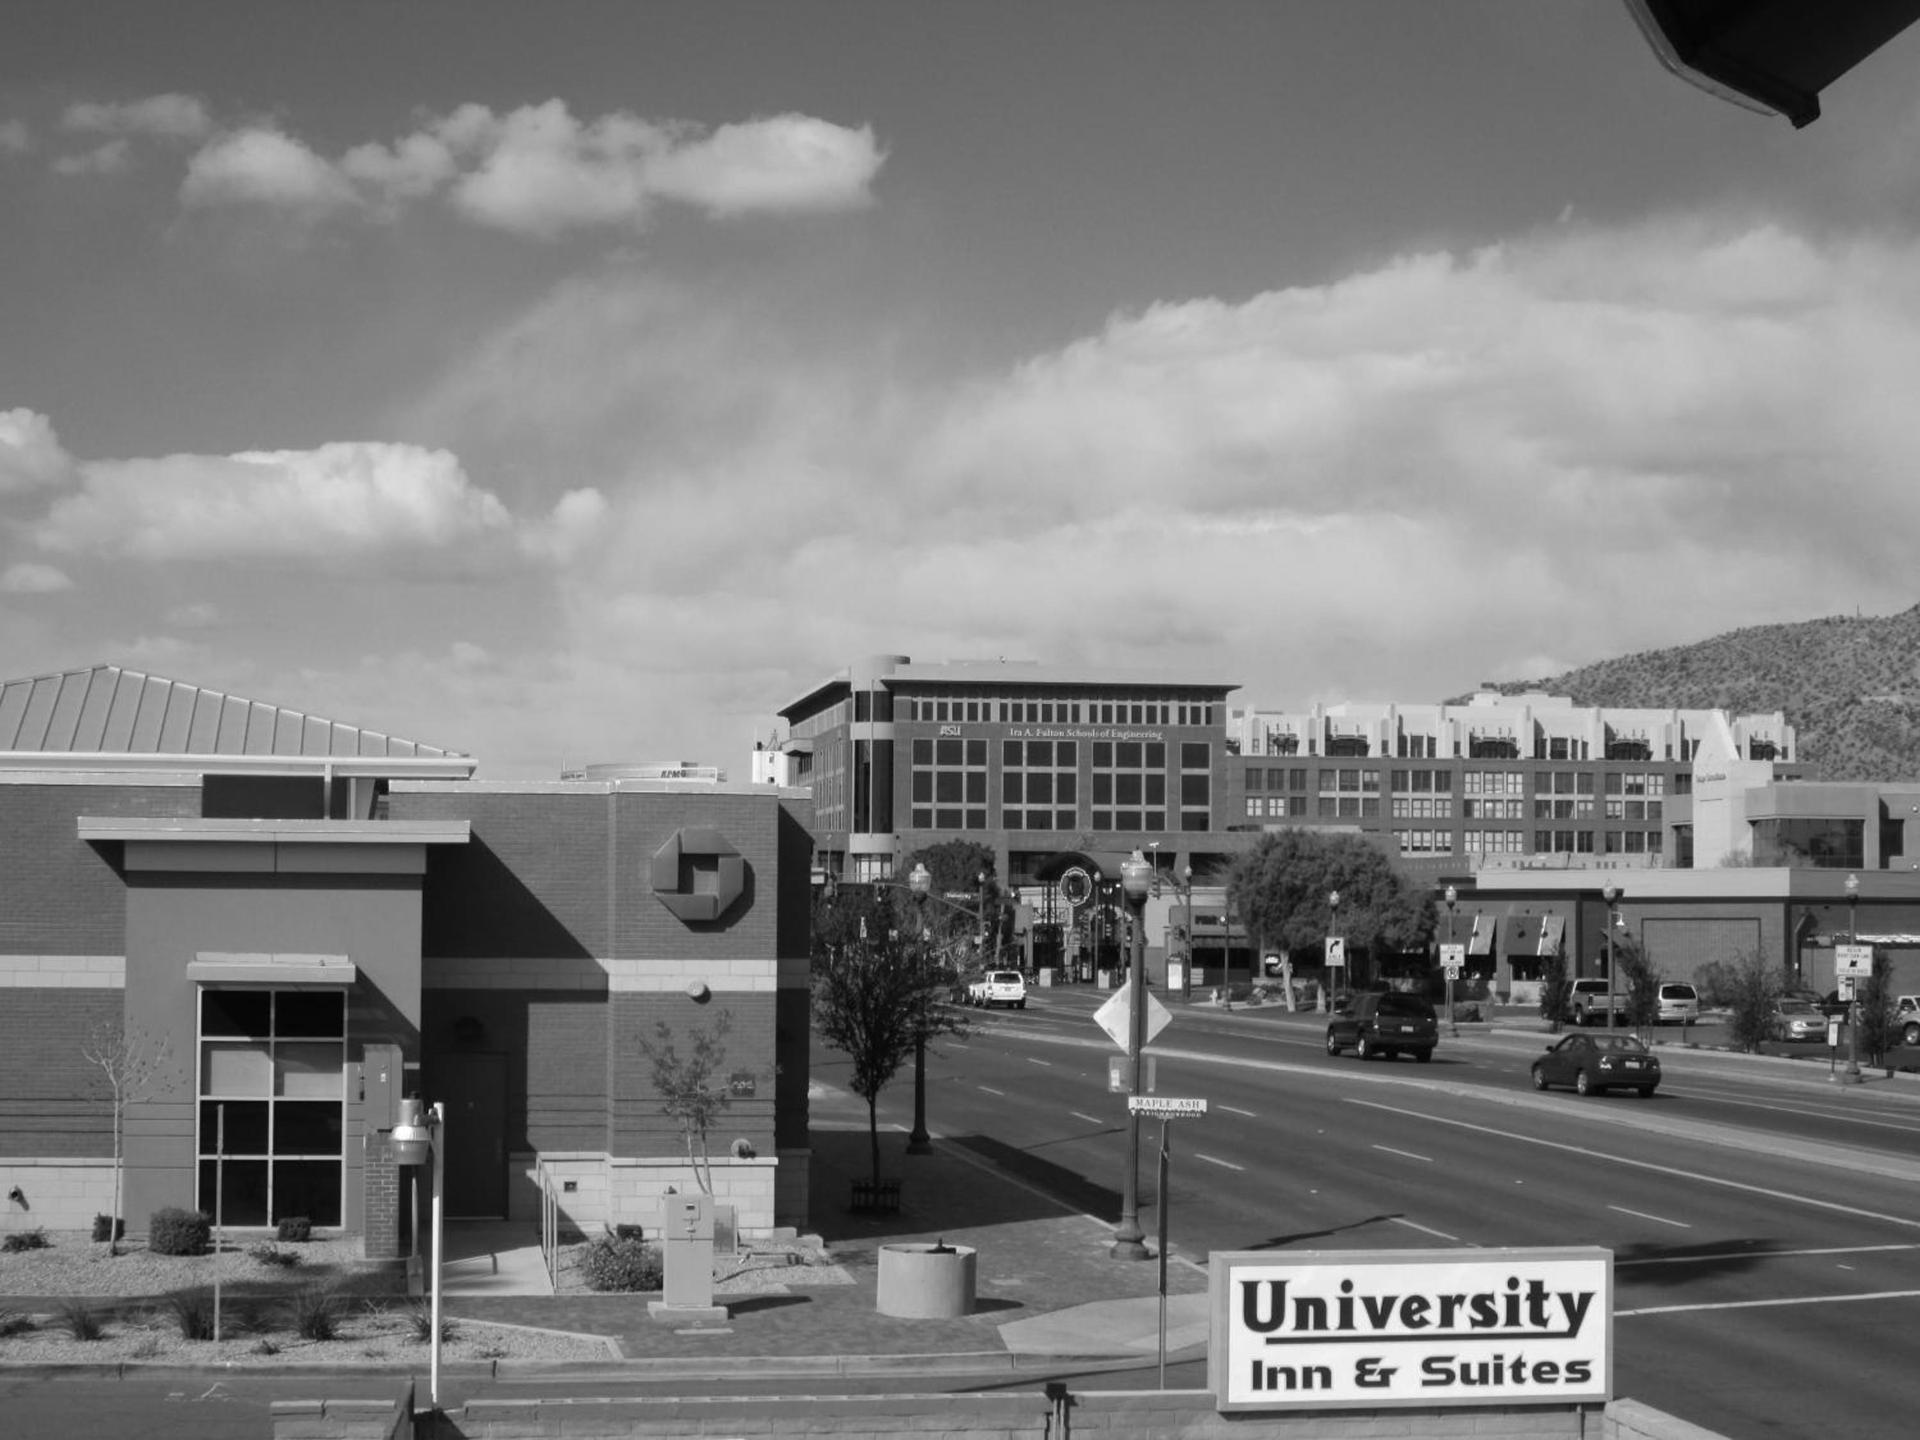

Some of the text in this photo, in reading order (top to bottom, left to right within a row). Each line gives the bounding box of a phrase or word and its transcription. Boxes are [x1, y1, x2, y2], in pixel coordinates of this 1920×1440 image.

[940, 725, 961, 737] ASU
[1009, 727, 1164, 740] Ira A. Fulton Schools of Engineering
[1136, 1098, 1201, 1109] MAPLE ASH
[1239, 1275, 1596, 1338] University
[1252, 1353, 1594, 1391] Inn & Suites
